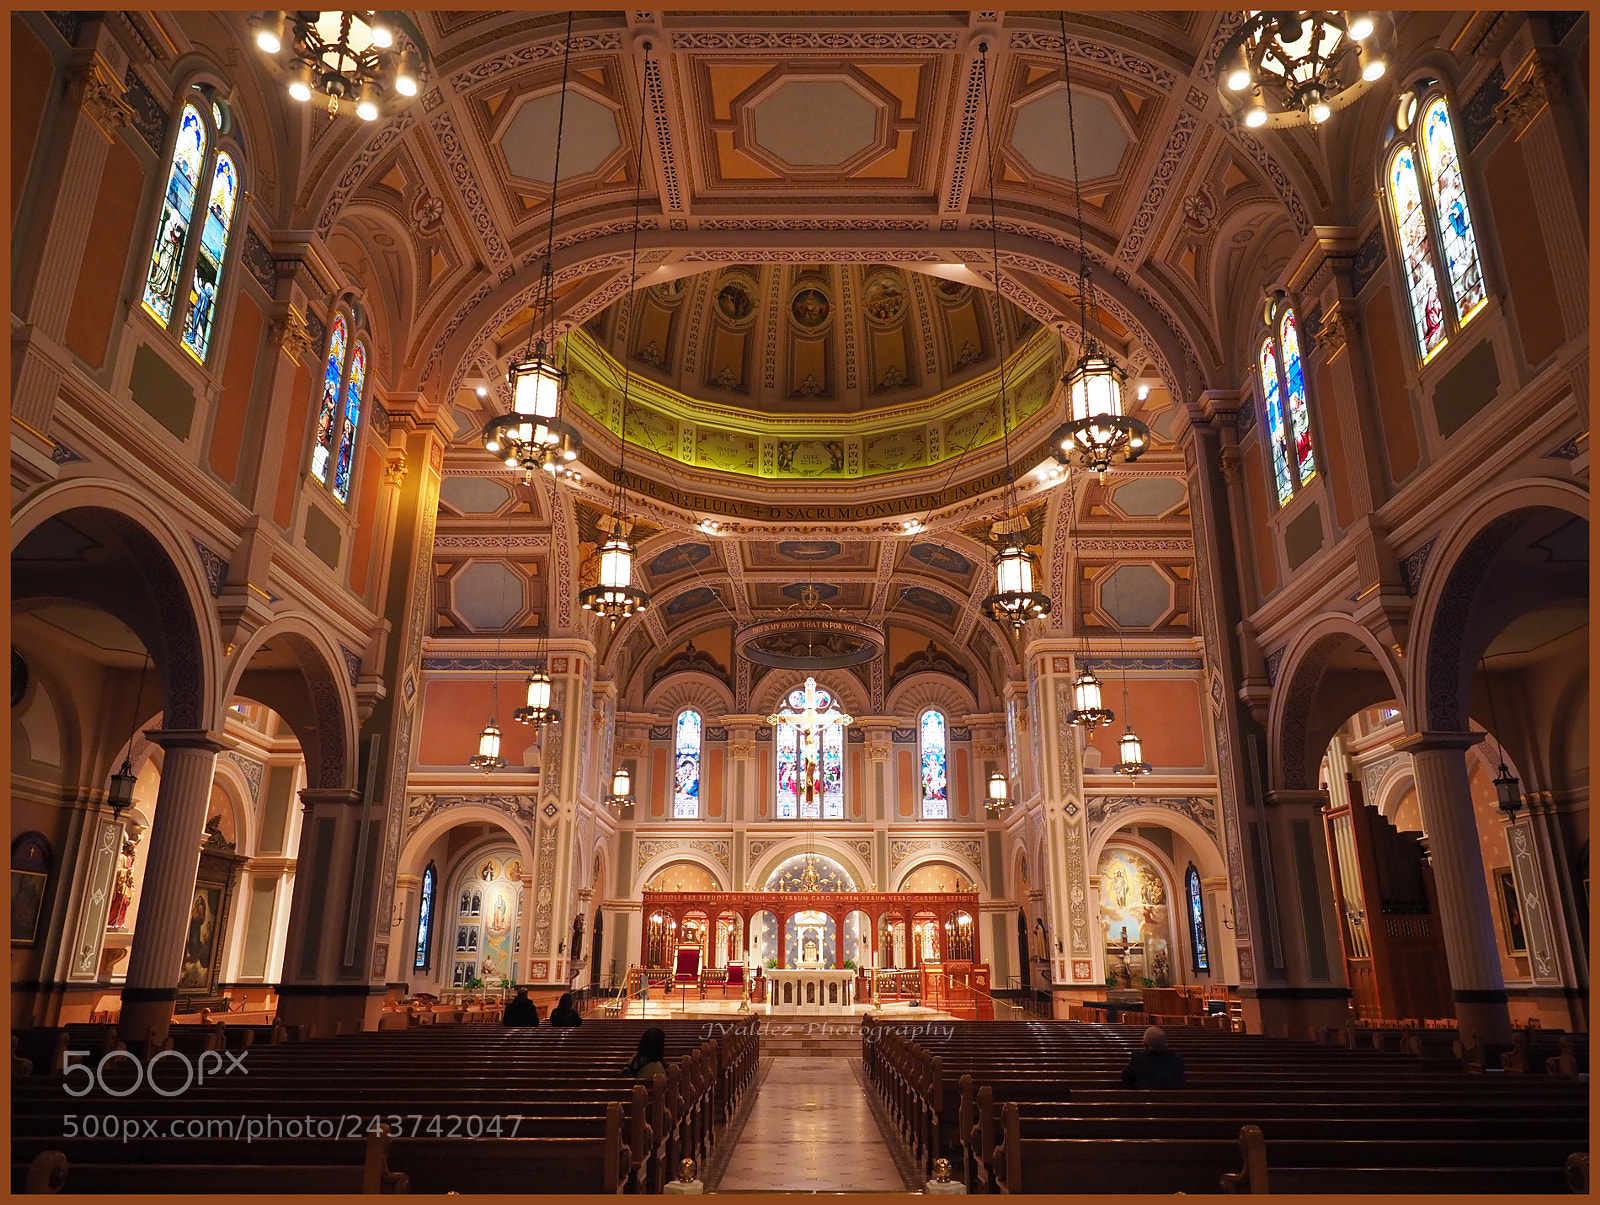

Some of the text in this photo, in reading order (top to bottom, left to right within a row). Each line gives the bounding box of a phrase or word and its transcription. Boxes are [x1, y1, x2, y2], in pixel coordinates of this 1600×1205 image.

[668, 491, 744, 515] ALLELUIA!
[770, 508, 781, 519] O
[786, 507, 850, 519] SACRUM
[855, 492, 946, 518] CONVIVIUM!
[954, 485, 968, 499] IN
[972, 473, 1001, 494] QUO
[752, 627, 763, 635] THIS
[829, 622, 842, 630] FOR
[843, 623, 857, 632] YOU
